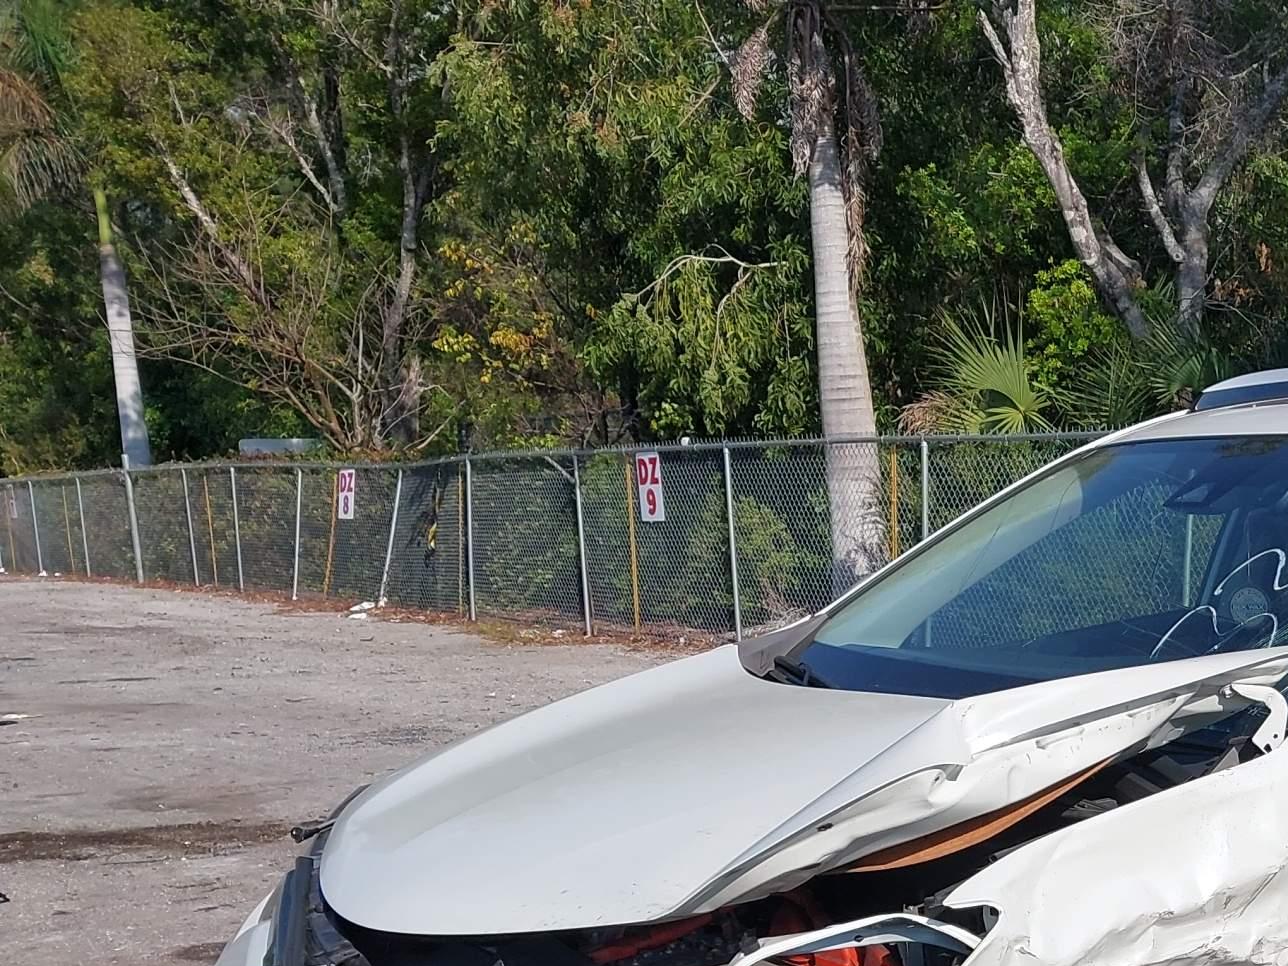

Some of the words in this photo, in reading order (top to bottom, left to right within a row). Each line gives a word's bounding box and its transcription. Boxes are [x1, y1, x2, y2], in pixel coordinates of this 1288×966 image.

[340, 472, 354, 493] DZ
[637, 457, 660, 486] DZ
[342, 494, 350, 515] 8
[646, 488, 657, 516] 9
